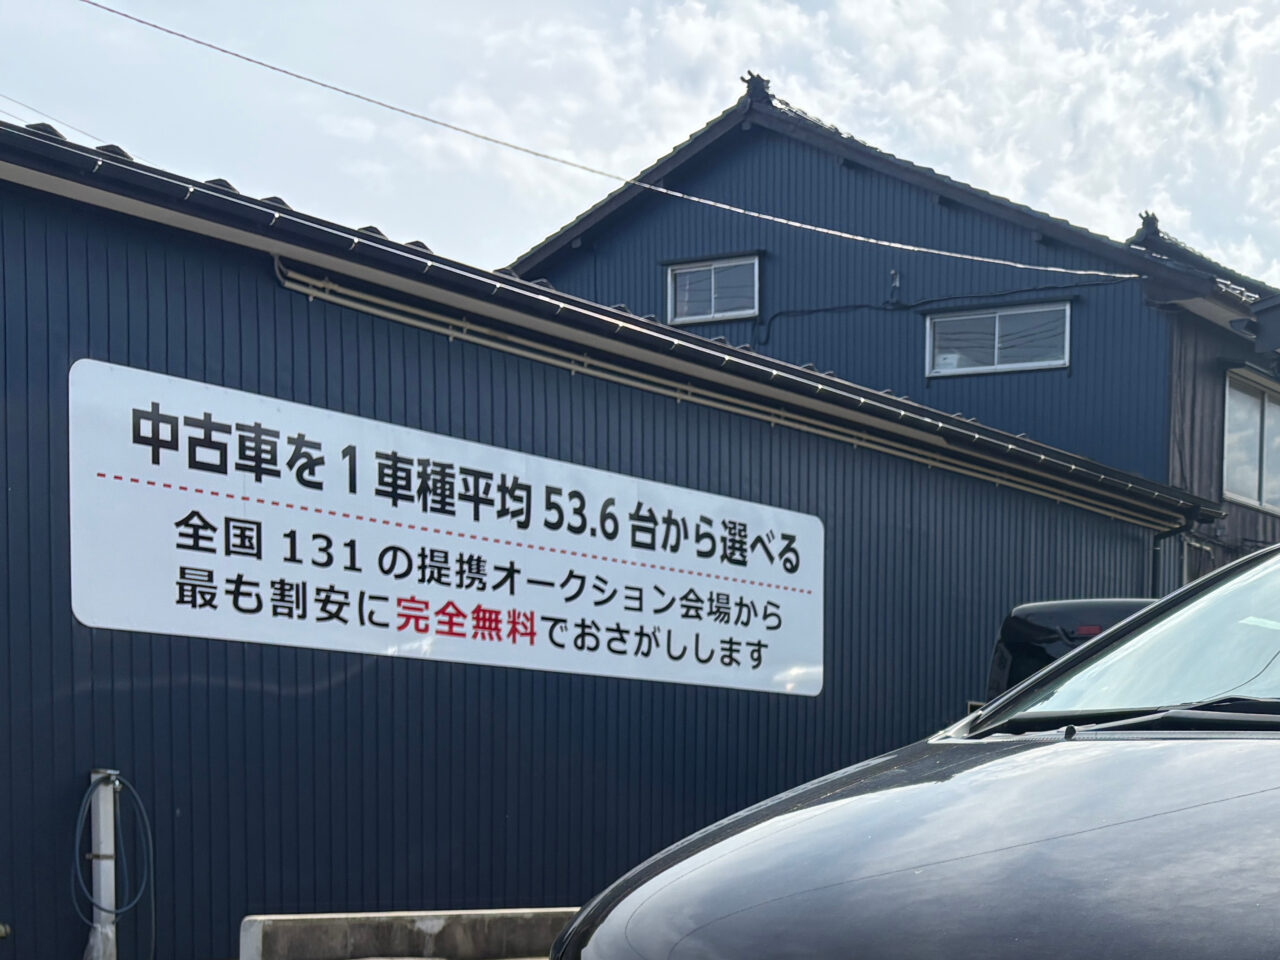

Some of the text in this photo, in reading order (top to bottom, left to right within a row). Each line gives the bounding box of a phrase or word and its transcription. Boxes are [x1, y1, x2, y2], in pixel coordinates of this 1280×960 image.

[175, 566, 768, 669] 最も割安に完全無料でおさがしします
